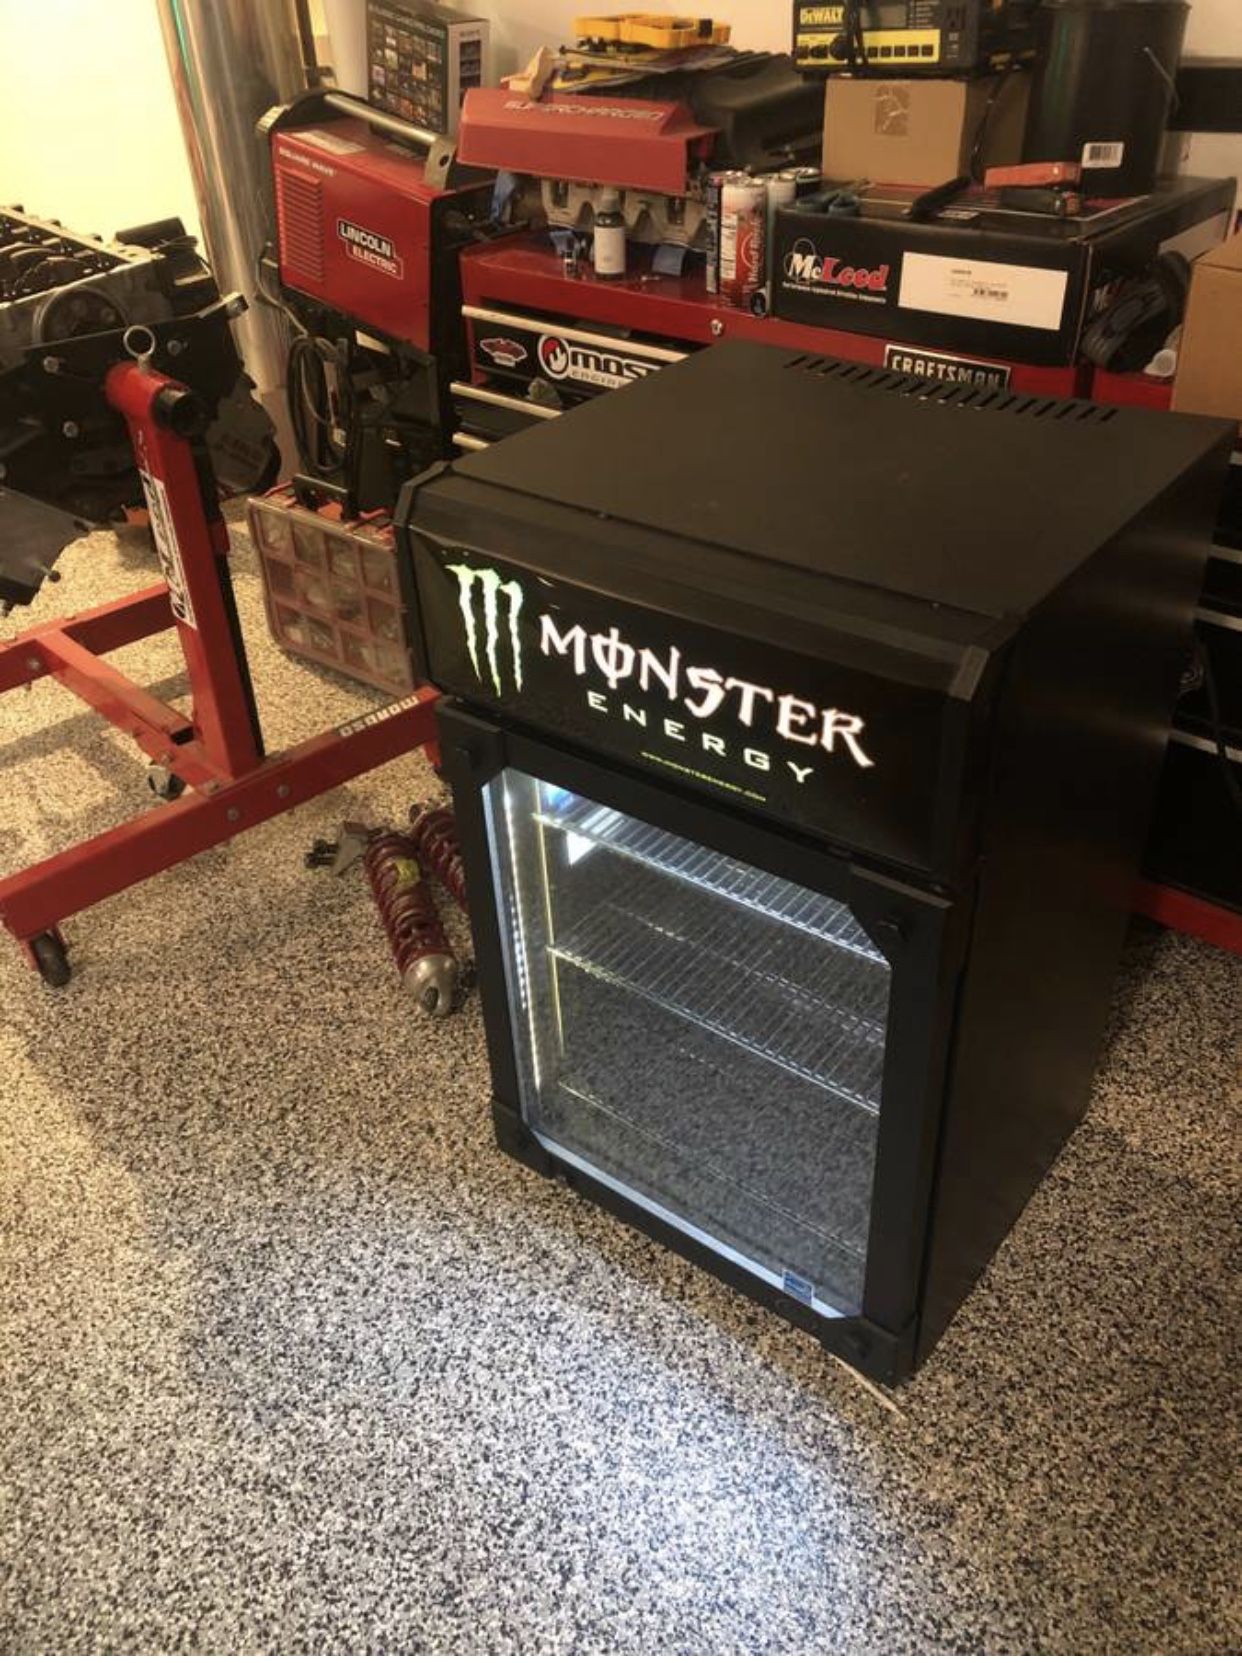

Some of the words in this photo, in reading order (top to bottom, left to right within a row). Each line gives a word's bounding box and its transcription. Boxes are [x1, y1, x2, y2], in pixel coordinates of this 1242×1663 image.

[340, 221, 391, 257] LINCOLN
[352, 244, 397, 274] ELECTRIC
[891, 354, 1000, 385] CRAFTSMAN
[587, 690, 814, 783] ENERGY
